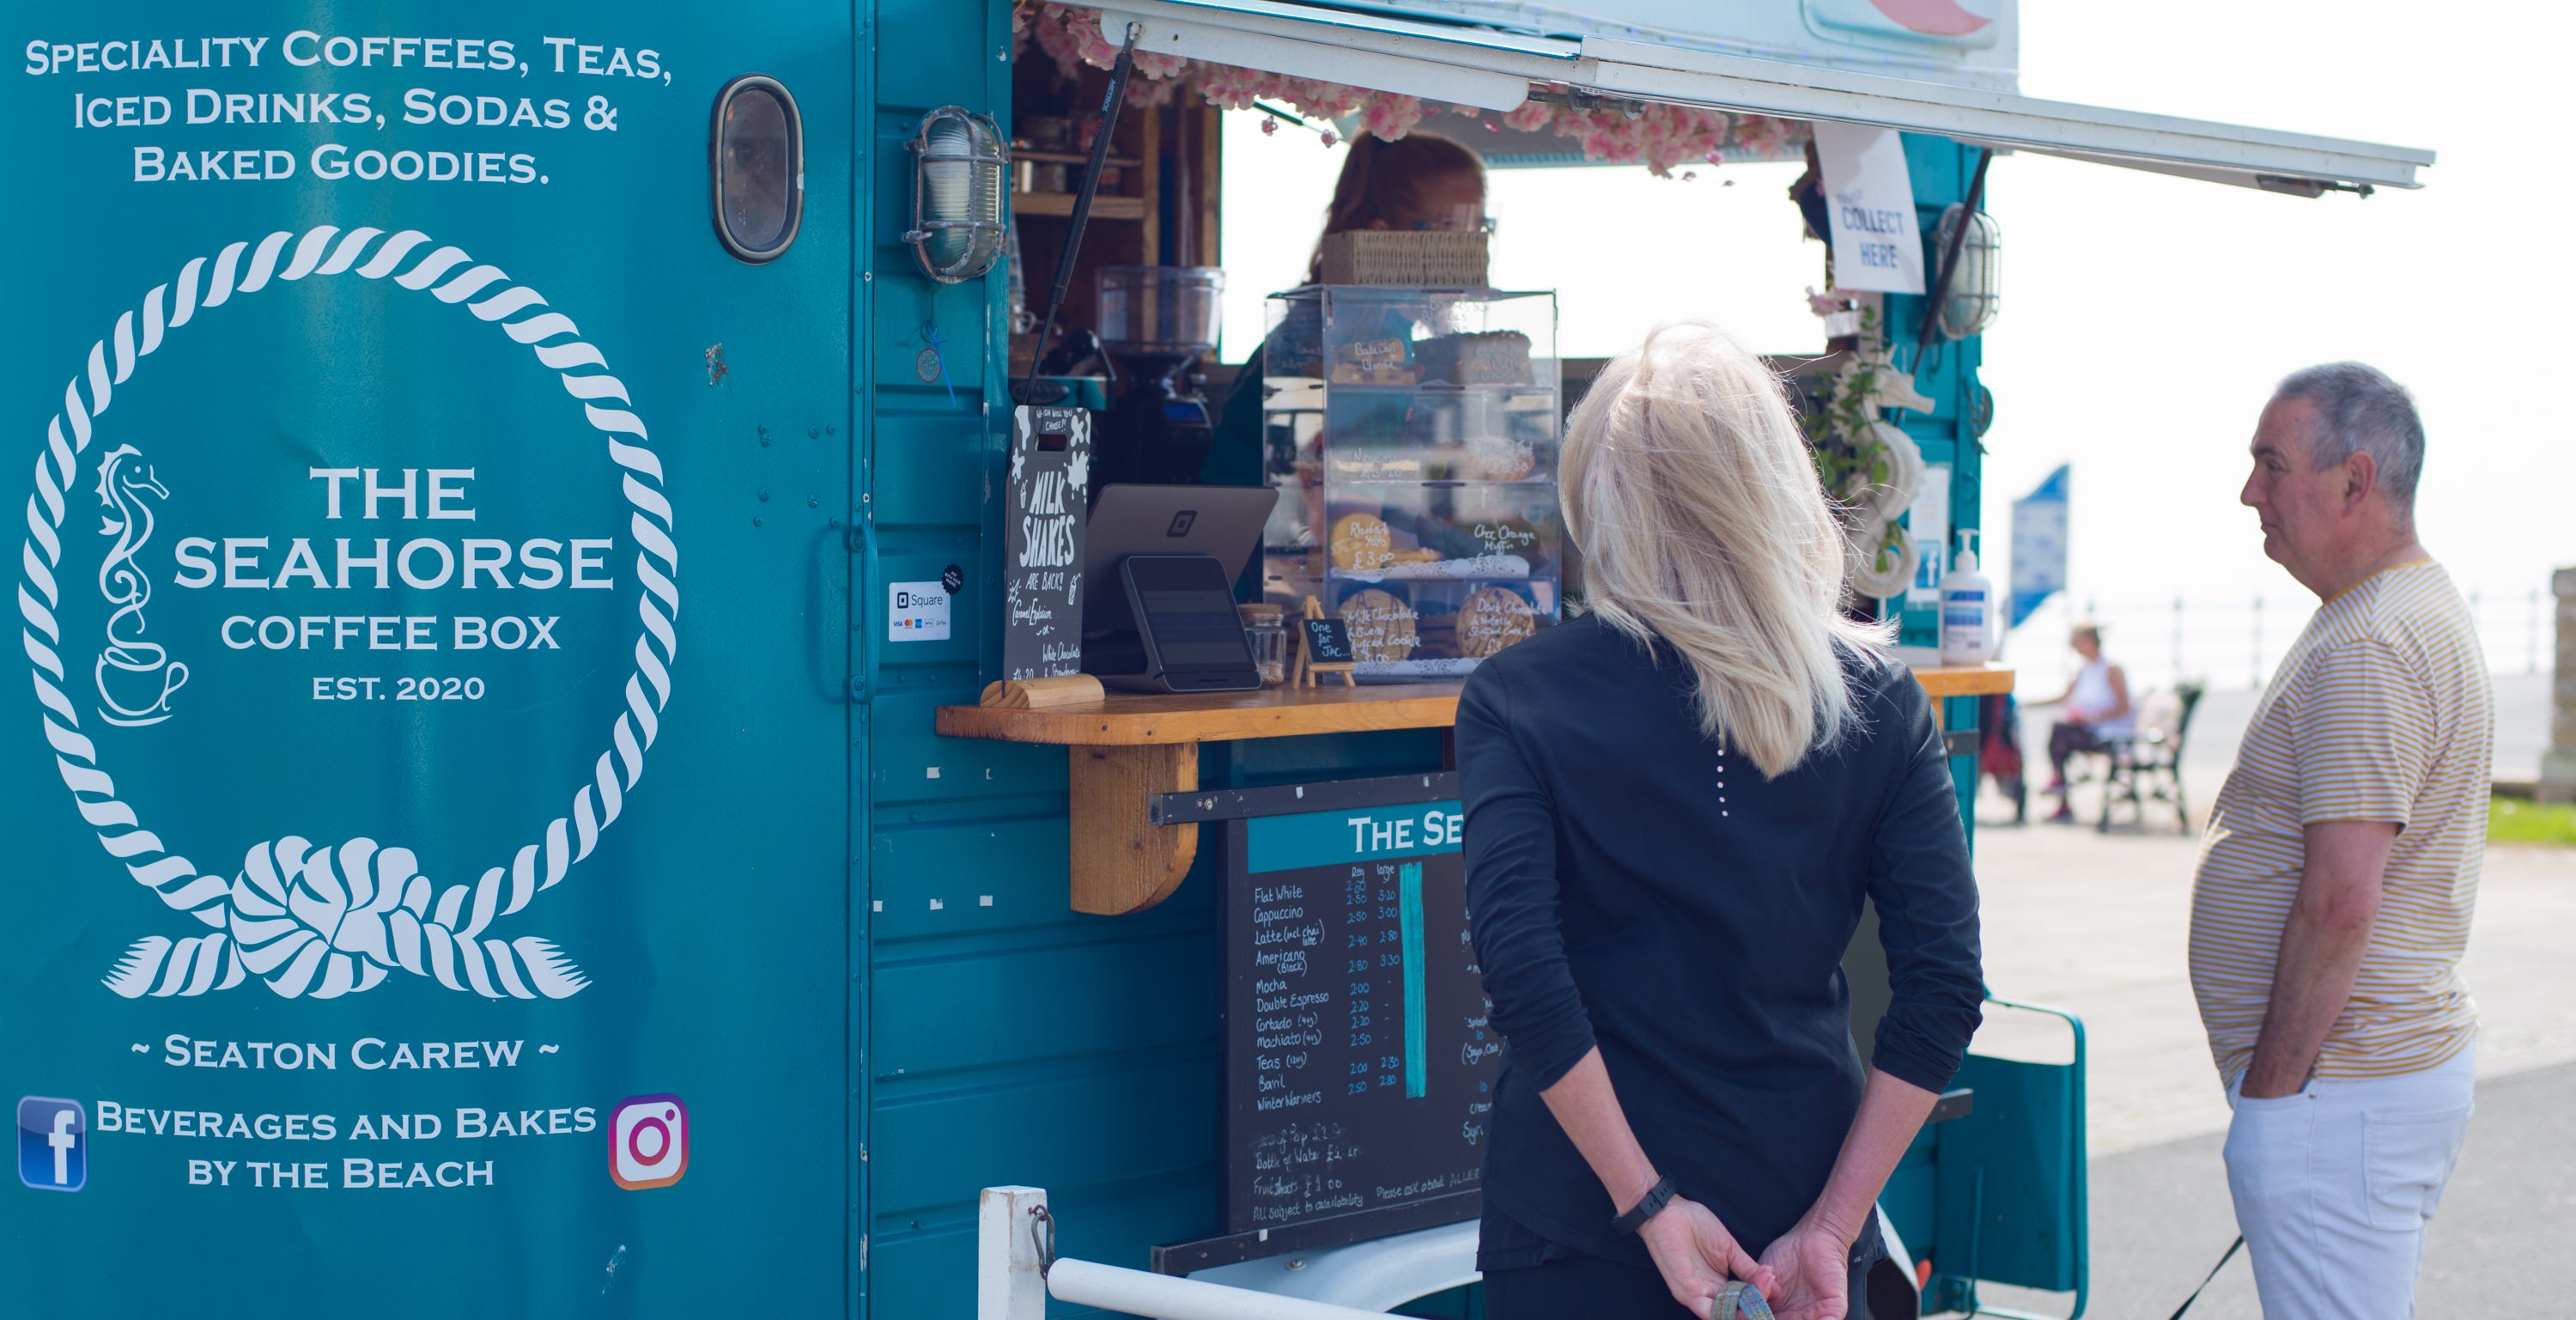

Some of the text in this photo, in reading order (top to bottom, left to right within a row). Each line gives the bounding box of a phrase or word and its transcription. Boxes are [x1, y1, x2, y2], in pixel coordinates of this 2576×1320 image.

[27, 29, 672, 84] SPECIALITY COFFEES, TEAS,
[75, 88, 617, 131] ICED DRINKS, SODAS &
[134, 143, 550, 185] BAKED GOODIES.
[1842, 206, 1904, 235] COLLECT
[1860, 242, 1898, 269] HERE
[310, 466, 476, 521] THE
[1030, 471, 1066, 514] MILK
[1019, 514, 1075, 568] SHAKES
[1474, 524, 1536, 546] Choc Orange
[1484, 540, 1514, 557] Muffin
[173, 536, 614, 590] SEAHORSE
[1025, 571, 1064, 592] ARE BACK!
[911, 594, 943, 608] Square
[221, 615, 561, 650] COFFEE BOX
[1310, 622, 1332, 633] One
[1318, 633, 1333, 646] for
[313, 677, 485, 702] EST. 2020
[1348, 816, 1414, 853] THE
[1255, 885, 1303, 903] Flat White
[1254, 905, 1303, 928] Cappuccino
[1255, 929, 1283, 946] Latte
[1255, 949, 1305, 966] Americano
[1256, 978, 1287, 995] Mocha
[1257, 992, 1329, 1013] Double Espresso
[1256, 1016, 1291, 1031] Cortado
[164, 1034, 336, 1070] SEATON
[351, 1037, 524, 1070] CAREW
[1256, 1055, 1280, 1070] Teas
[1257, 1097, 1285, 1111] Winter
[97, 1100, 597, 1141] BEVERAGES AND BAKES
[188, 1158, 494, 1189] BY THE BEACH
[1376, 1175, 1444, 1200] Please ask about
[1269, 1202, 1301, 1221] subject
[1305, 1201, 1313, 1213] to
[1315, 1193, 1364, 1210] availability
